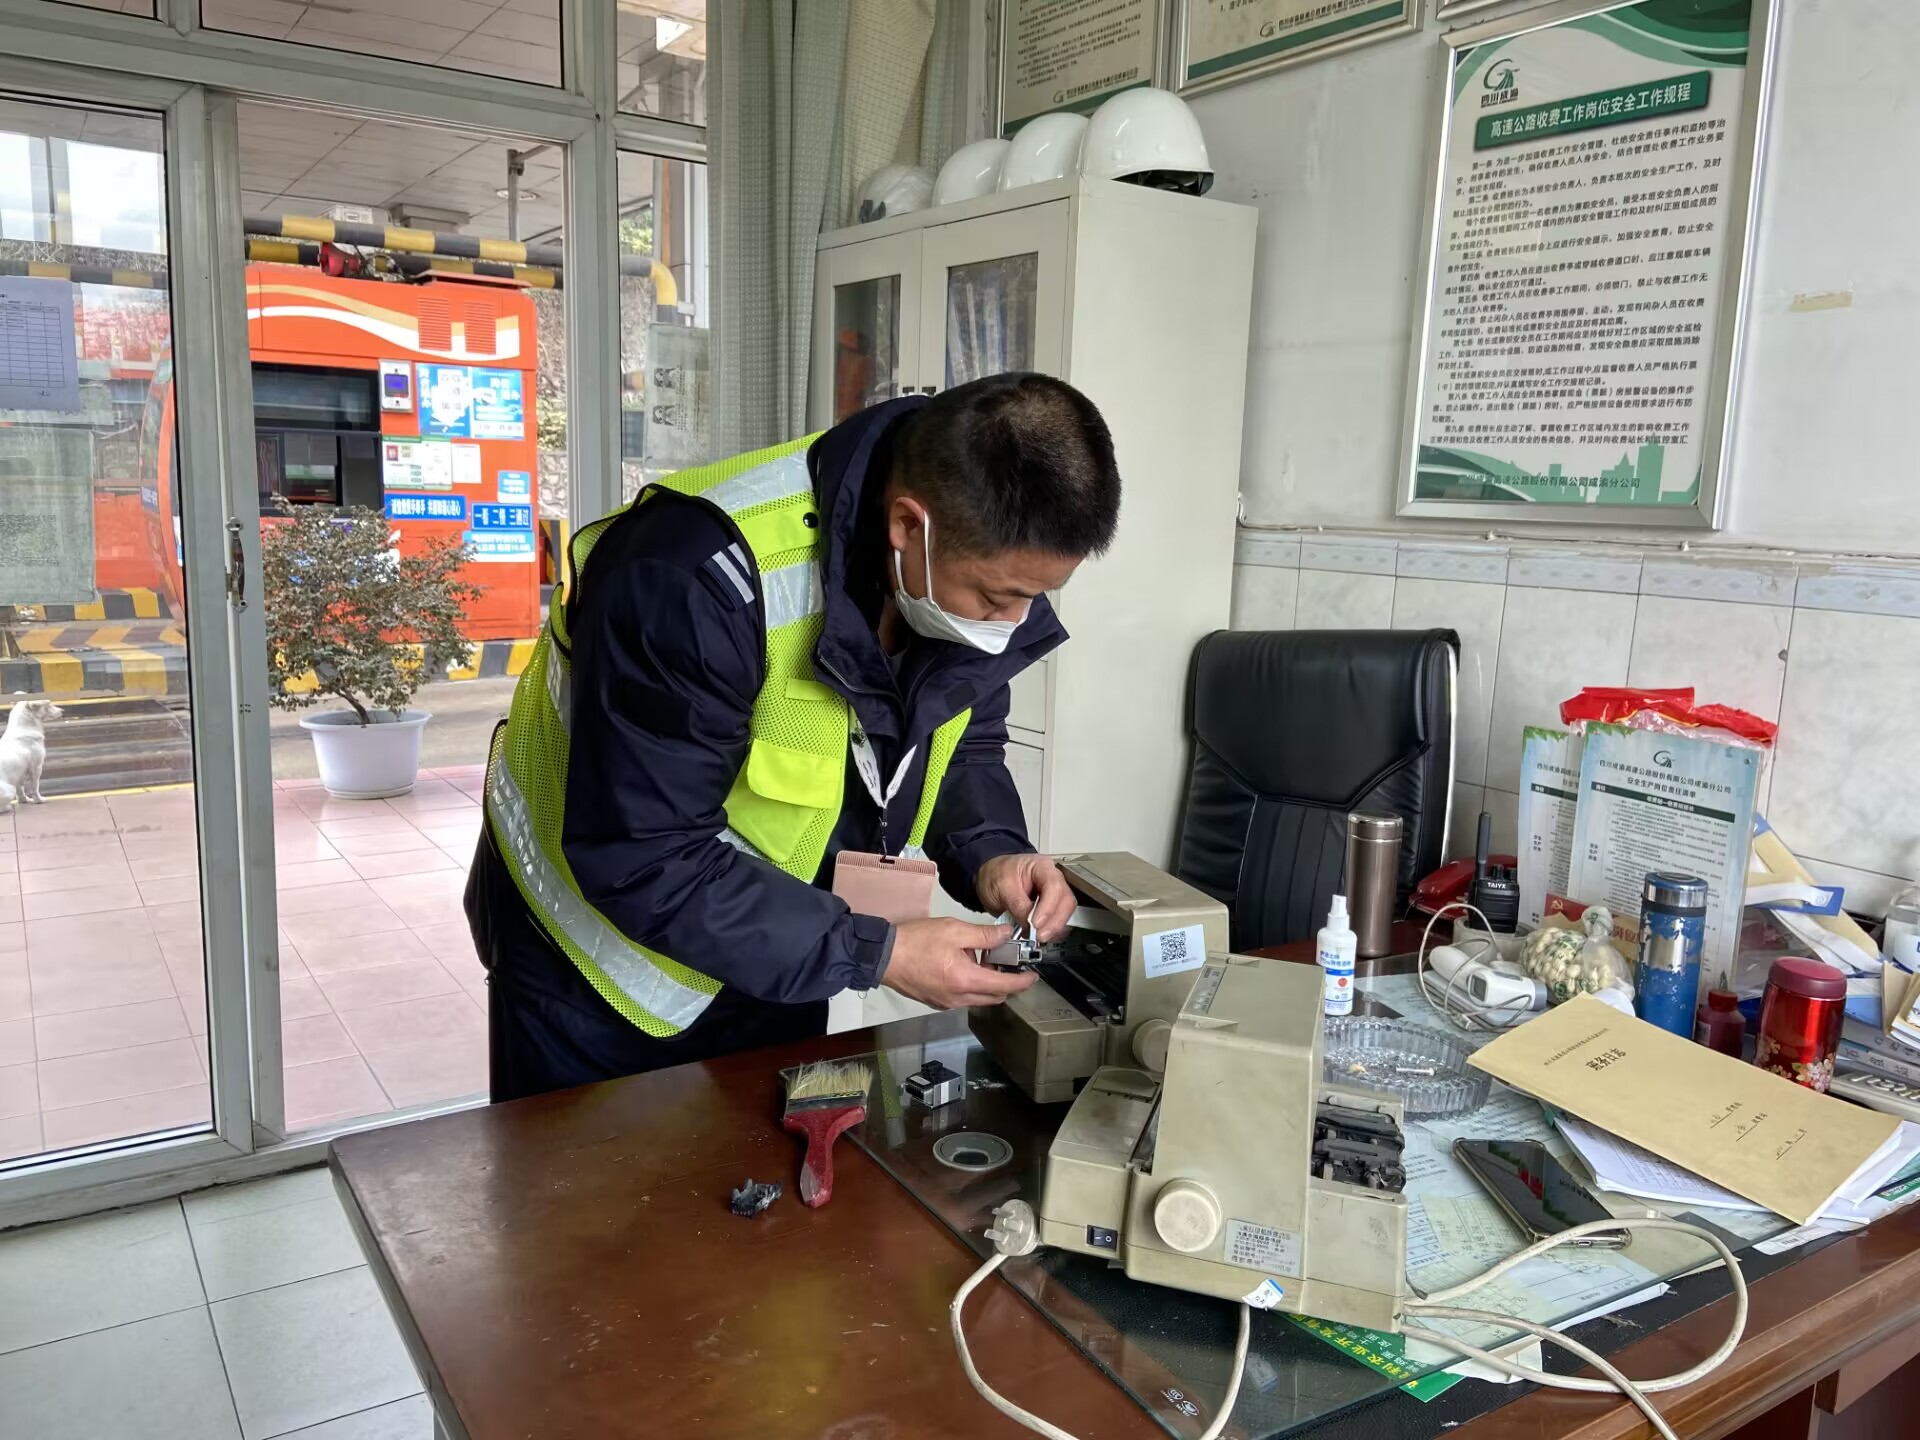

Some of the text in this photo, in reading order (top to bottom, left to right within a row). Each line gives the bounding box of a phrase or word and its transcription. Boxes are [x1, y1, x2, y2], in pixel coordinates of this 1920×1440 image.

[1491, 82, 1691, 138] 高速公路收费工作岗位安全工作规程
